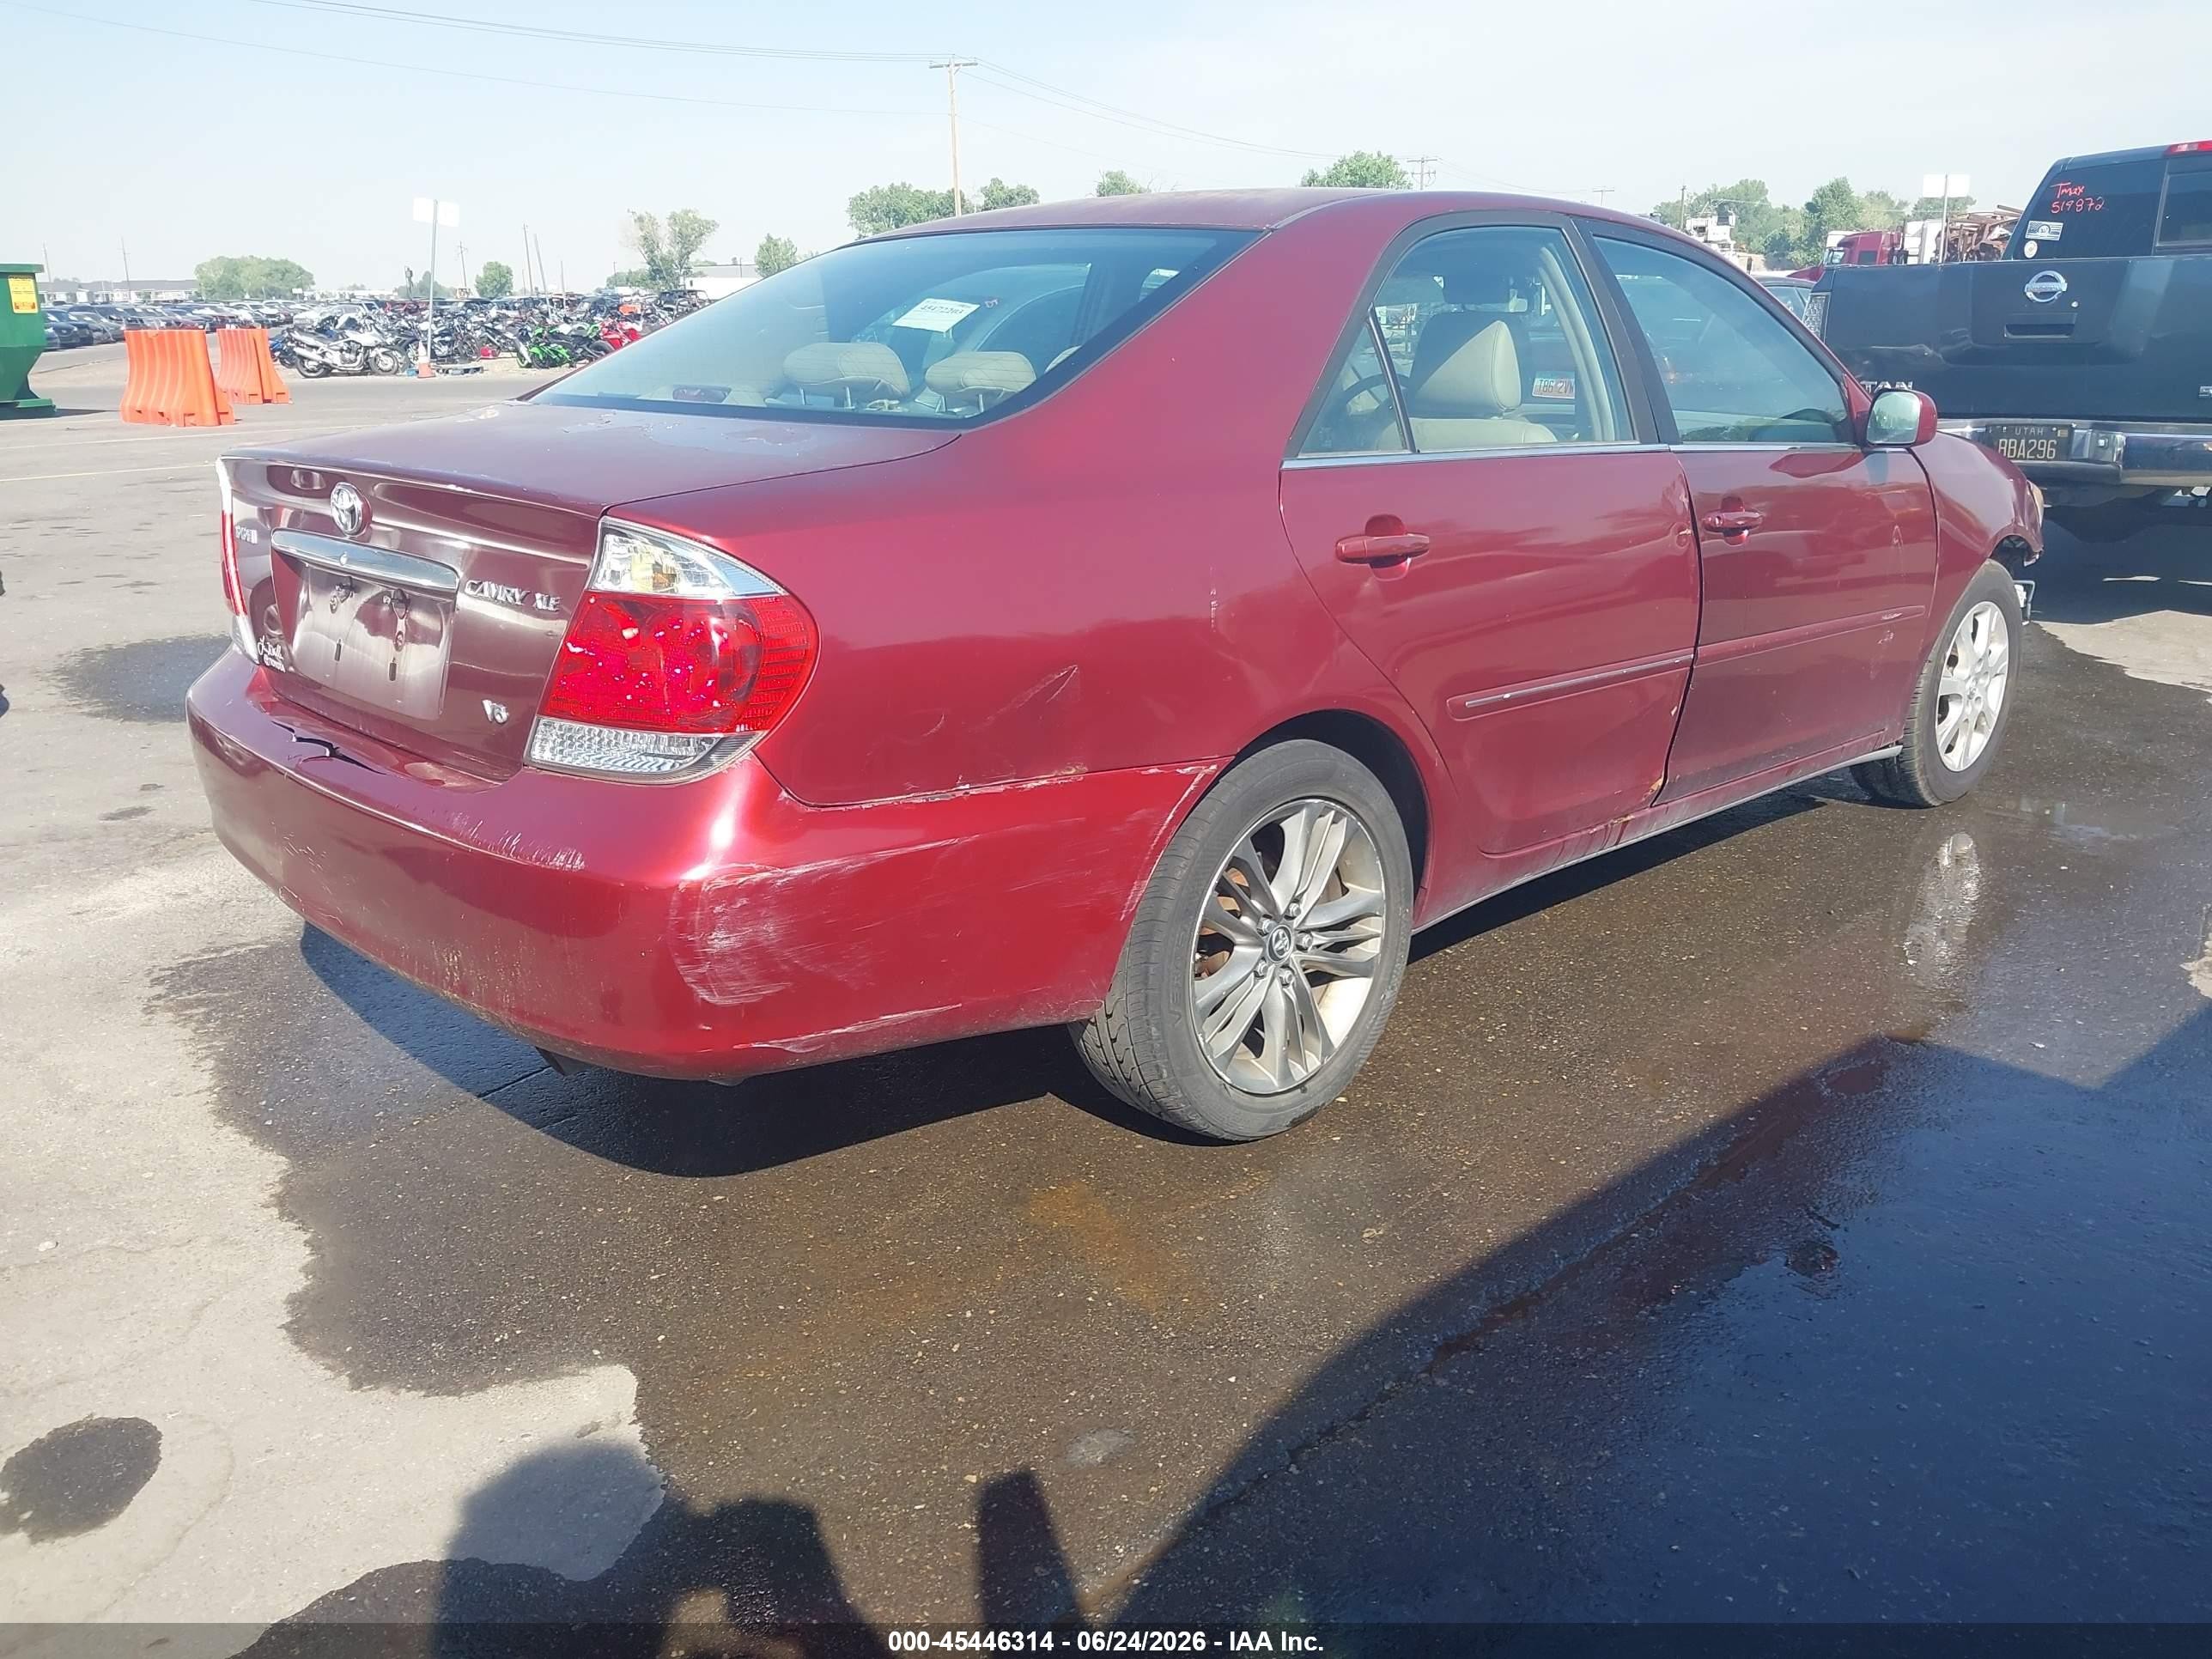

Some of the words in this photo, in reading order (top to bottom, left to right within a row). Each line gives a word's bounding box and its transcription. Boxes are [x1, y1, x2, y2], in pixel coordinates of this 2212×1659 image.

[2051, 196, 2106, 214] 519872
[2014, 426, 2044, 436] UTAH
[464, 580, 531, 606] CAMRY
[482, 699, 509, 724] V6
